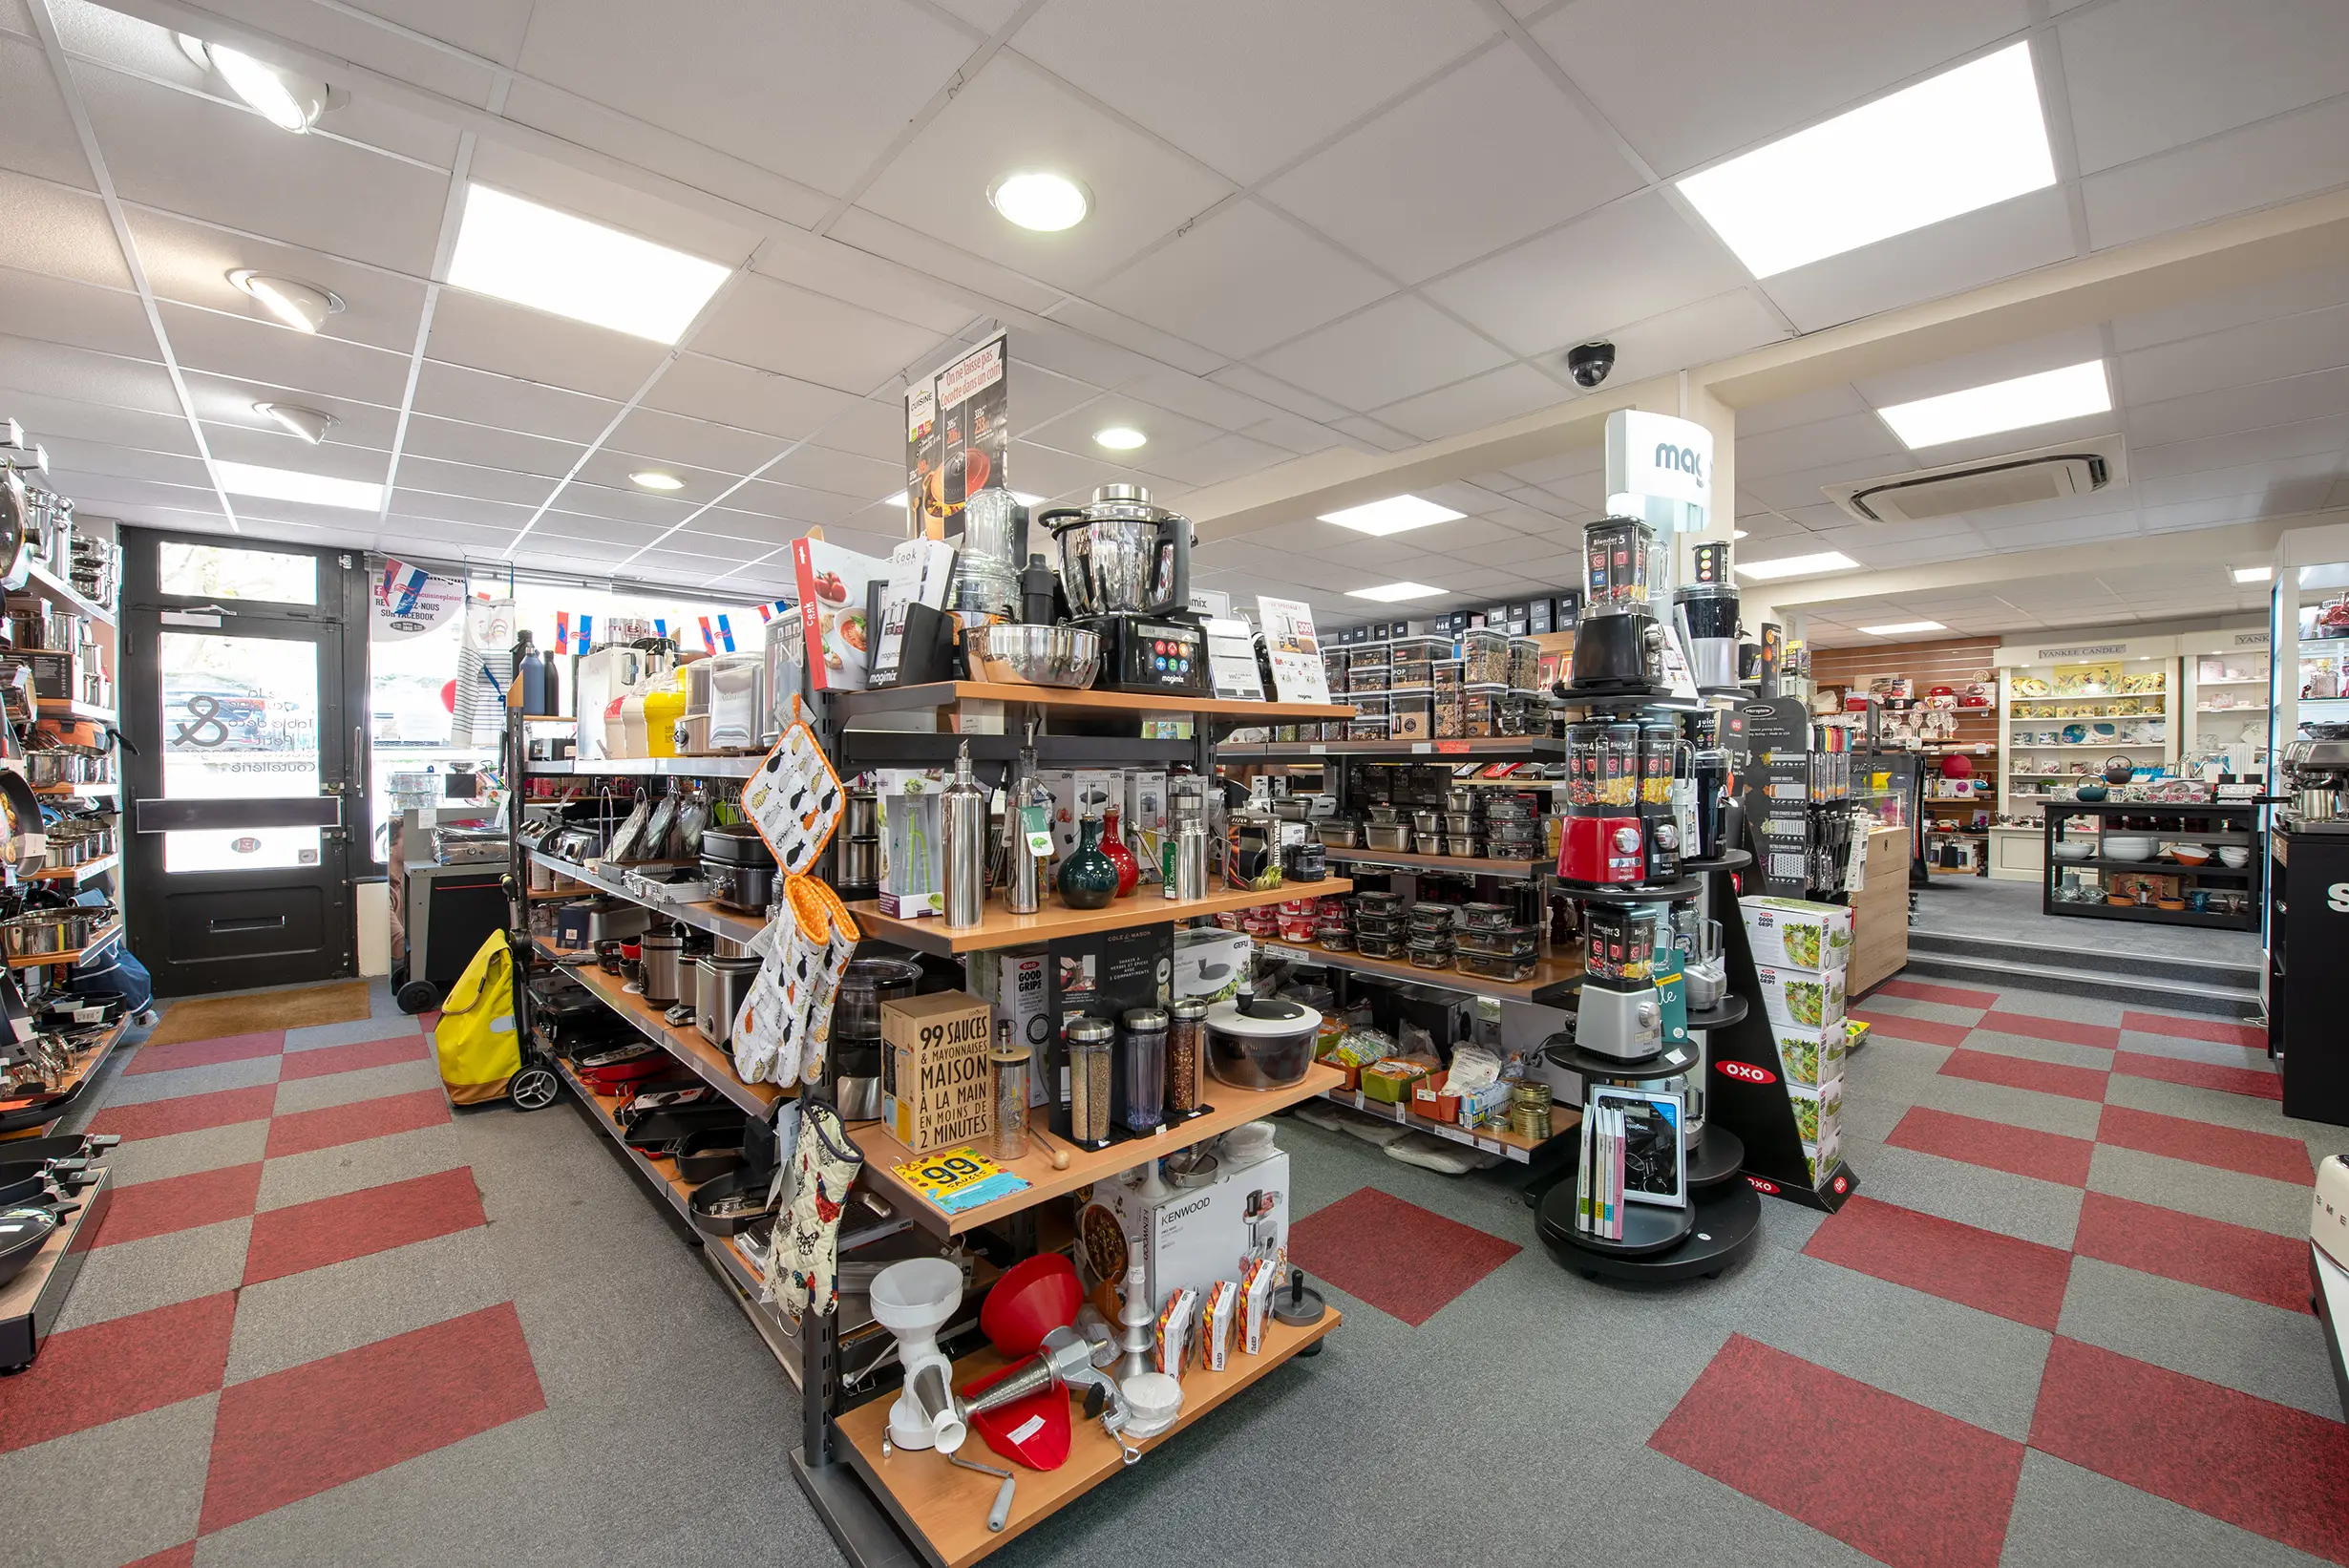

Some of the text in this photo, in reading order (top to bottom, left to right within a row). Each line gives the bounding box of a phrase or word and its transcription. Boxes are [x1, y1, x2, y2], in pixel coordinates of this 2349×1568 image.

[946, 350, 993, 386] On ne laisse pas
[941, 362, 1001, 407] Cocotte dans un coin
[911, 392, 933, 412] CUISINE
[1594, 535, 1625, 545] Blender 5
[896, 548, 917, 563] Cook
[804, 602, 813, 626] Cook
[2042, 649, 2080, 658] YANKEE
[869, 670, 898, 686] magimix
[1162, 675, 1185, 685] magimix
[1589, 742, 1594, 751] 4
[1614, 928, 1620, 937] 3
[1233, 940, 1249, 949] GEFU
[1018, 970, 1041, 982] GOOD
[1114, 970, 1149, 979] COMPARTIMENTS
[1018, 979, 1042, 992] GRIPS
[920, 1016, 987, 1050] 99 SAUCES
[921, 1040, 987, 1065] & MAYONNAISES
[921, 1054, 987, 1091] MAISON
[1726, 1064, 1764, 1080] OXO
[920, 1082, 986, 1114] À LA MAIN
[921, 1101, 986, 1128] EN MOINS DE
[921, 1114, 986, 1149] 2 MINUTES
[921, 1157, 981, 1184] 99
[1161, 1197, 1210, 1226] KENWOOD
